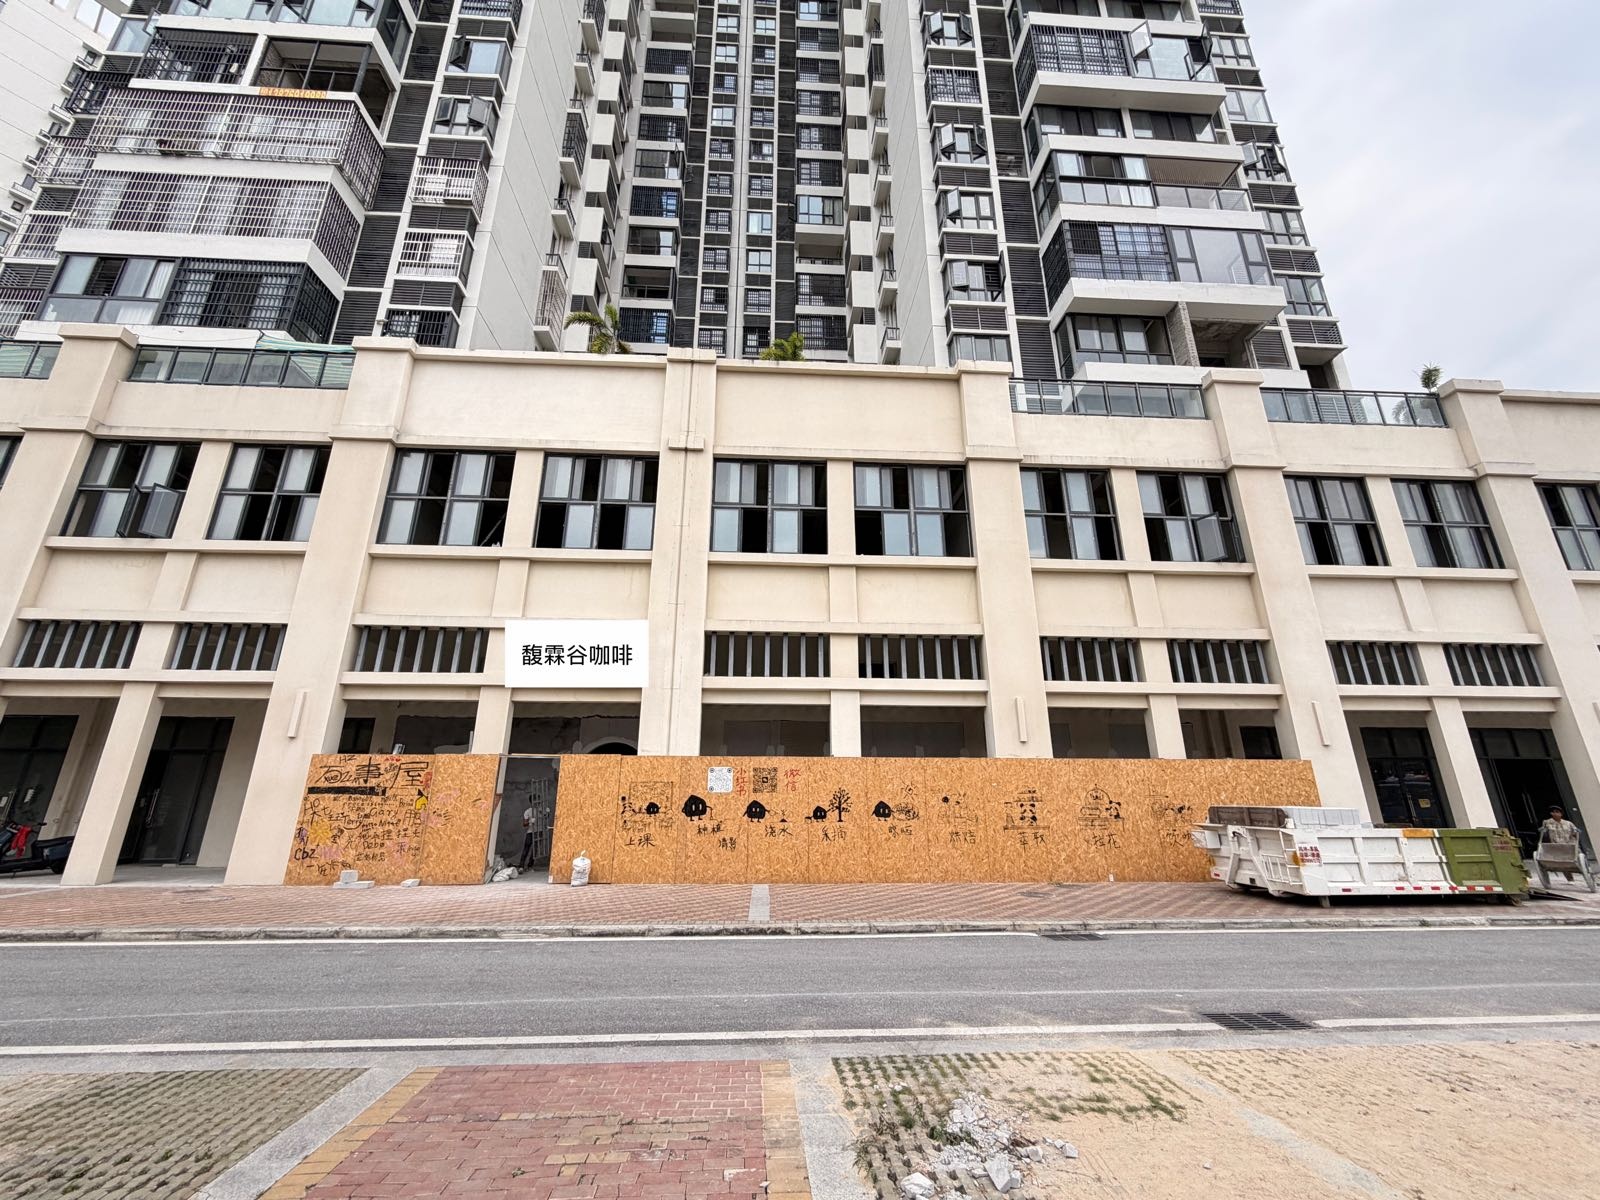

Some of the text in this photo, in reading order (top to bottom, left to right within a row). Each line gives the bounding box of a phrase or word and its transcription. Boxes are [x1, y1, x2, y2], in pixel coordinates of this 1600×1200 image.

[735, 767, 748, 796] 小红书
[784, 769, 801, 792] 微信
[764, 825, 793, 838] 浇水
[821, 825, 847, 842] 采摘
[950, 830, 976, 845] 烘焙
[625, 833, 656, 848] 上课
[1018, 831, 1047, 851] 萃取
